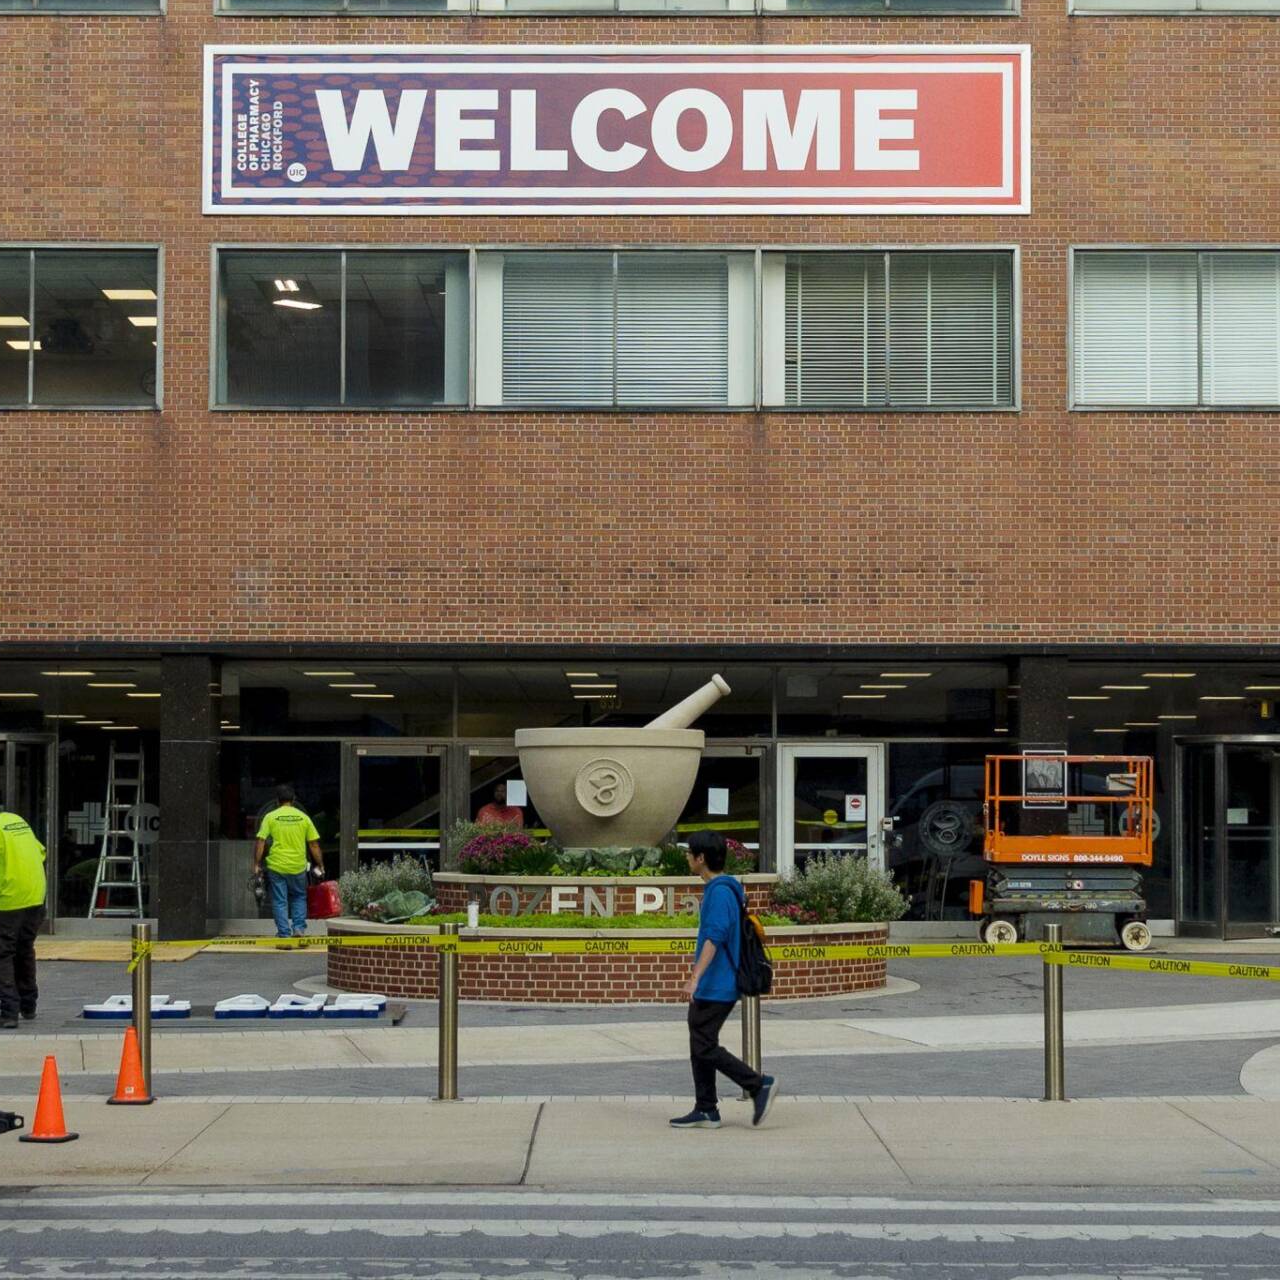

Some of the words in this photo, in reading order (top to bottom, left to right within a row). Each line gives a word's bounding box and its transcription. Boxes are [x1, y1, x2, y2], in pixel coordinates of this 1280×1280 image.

[249, 79, 260, 151] PHARMACY
[261, 113, 271, 171] CHICAGO
[273, 101, 283, 171] ROCKFORD
[314, 88, 921, 172] WELCOME
[237, 114, 247, 171] COLLEGE
[249, 155, 259, 171] OF
[1047, 853, 1070, 862] SIGNS
[385, 936, 430, 946] CAUTION
[498, 942, 543, 952] CAUTION
[584, 941, 629, 951] CAUTION
[669, 940, 696, 951] CAUT
[782, 947, 826, 958] CAUTION
[867, 946, 910, 957] CAUTION
[951, 944, 995, 955] CAUTION
[1069, 954, 1110, 967] CAUTION
[1149, 959, 1191, 972] CAUTION
[1229, 965, 1270, 978] CAUTION
